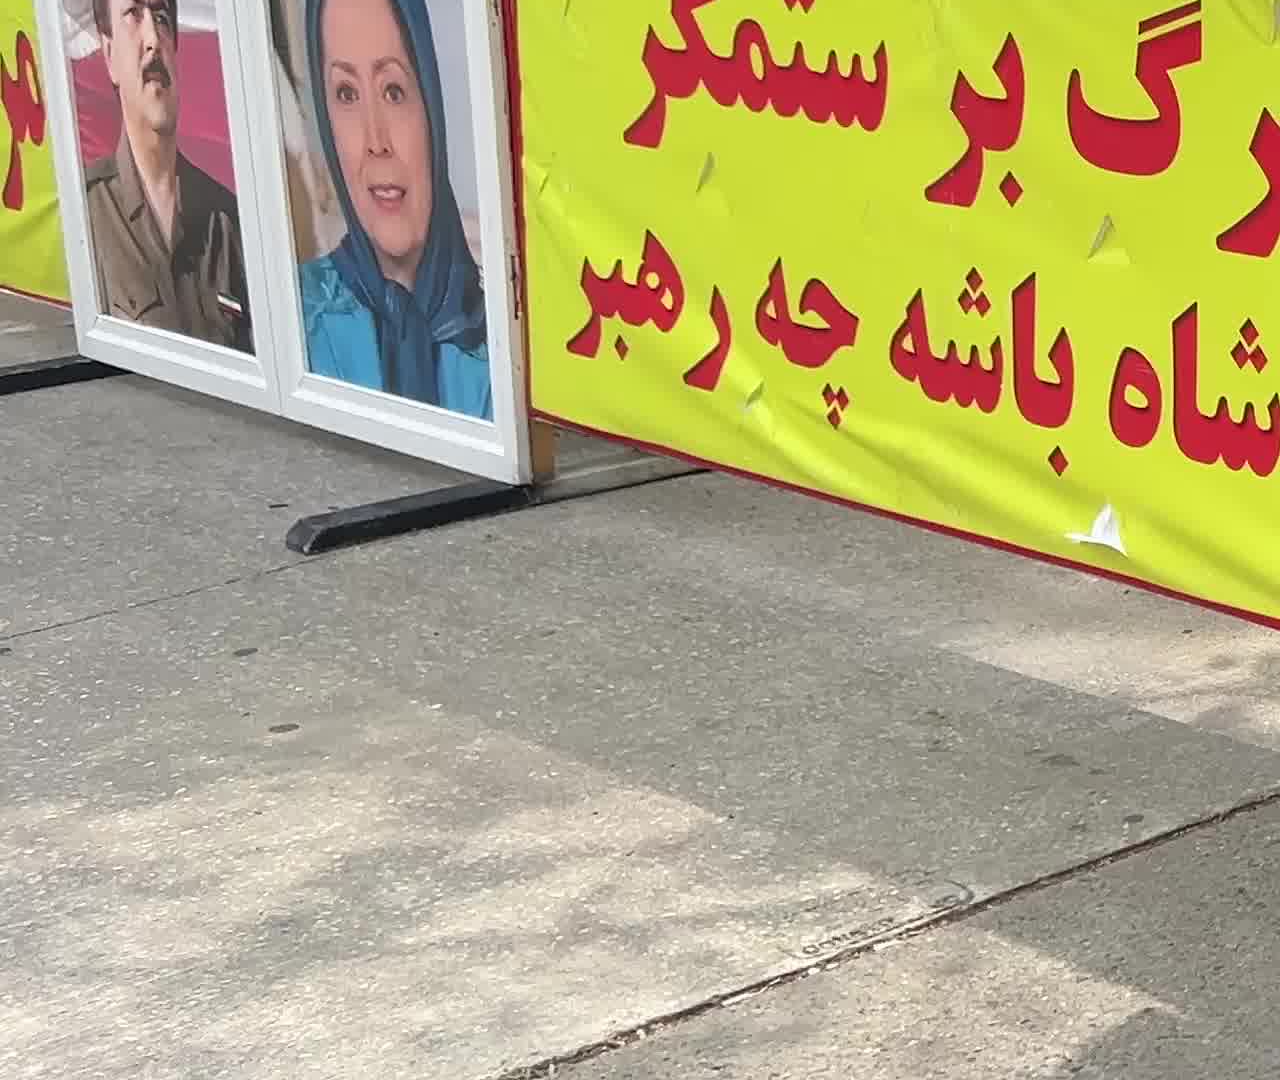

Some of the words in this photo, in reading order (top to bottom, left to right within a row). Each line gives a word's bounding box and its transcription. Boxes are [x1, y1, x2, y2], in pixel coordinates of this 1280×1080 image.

[927, 33, 1026, 208] بر
[754, 257, 859, 429] چه
[889, 266, 1075, 476] باشه
